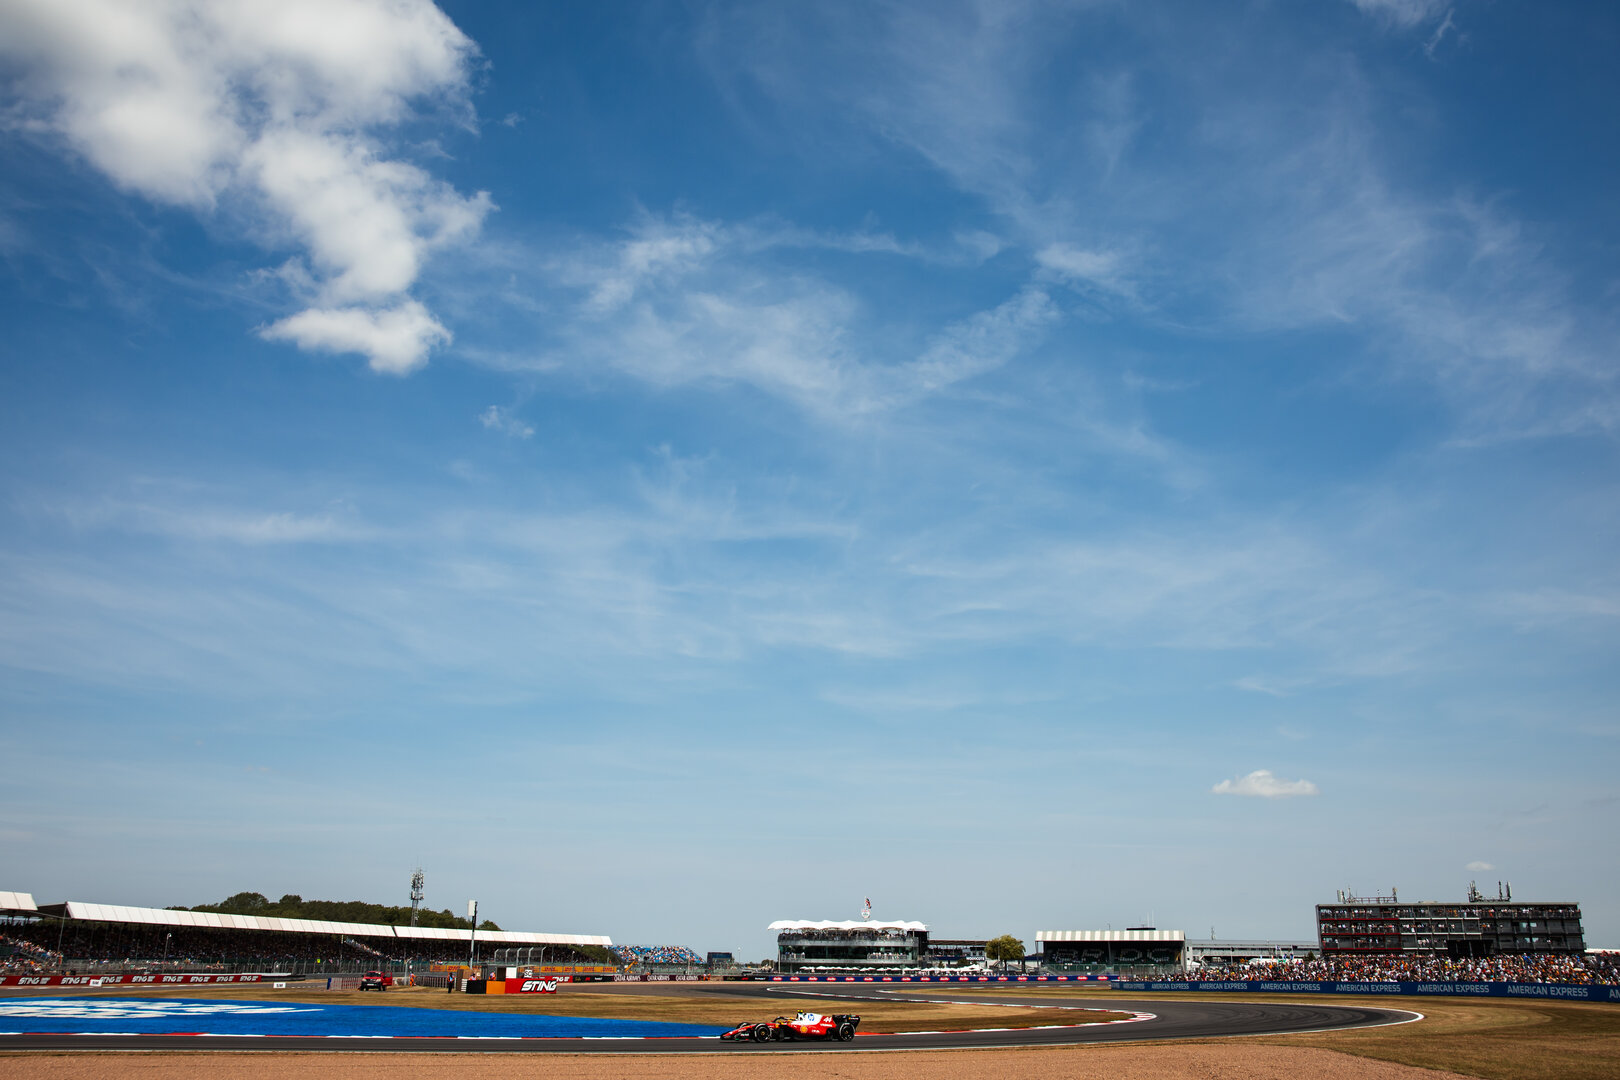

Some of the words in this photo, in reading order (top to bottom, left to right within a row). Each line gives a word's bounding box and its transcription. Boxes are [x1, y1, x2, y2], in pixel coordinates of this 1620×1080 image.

[520, 980, 557, 992] STING
[1336, 984, 1369, 992] AMERICAN
[1417, 984, 1454, 992] AMERICAN
[1508, 985, 1548, 994] AMERICAN
[1550, 987, 1588, 996] EXPRESS
